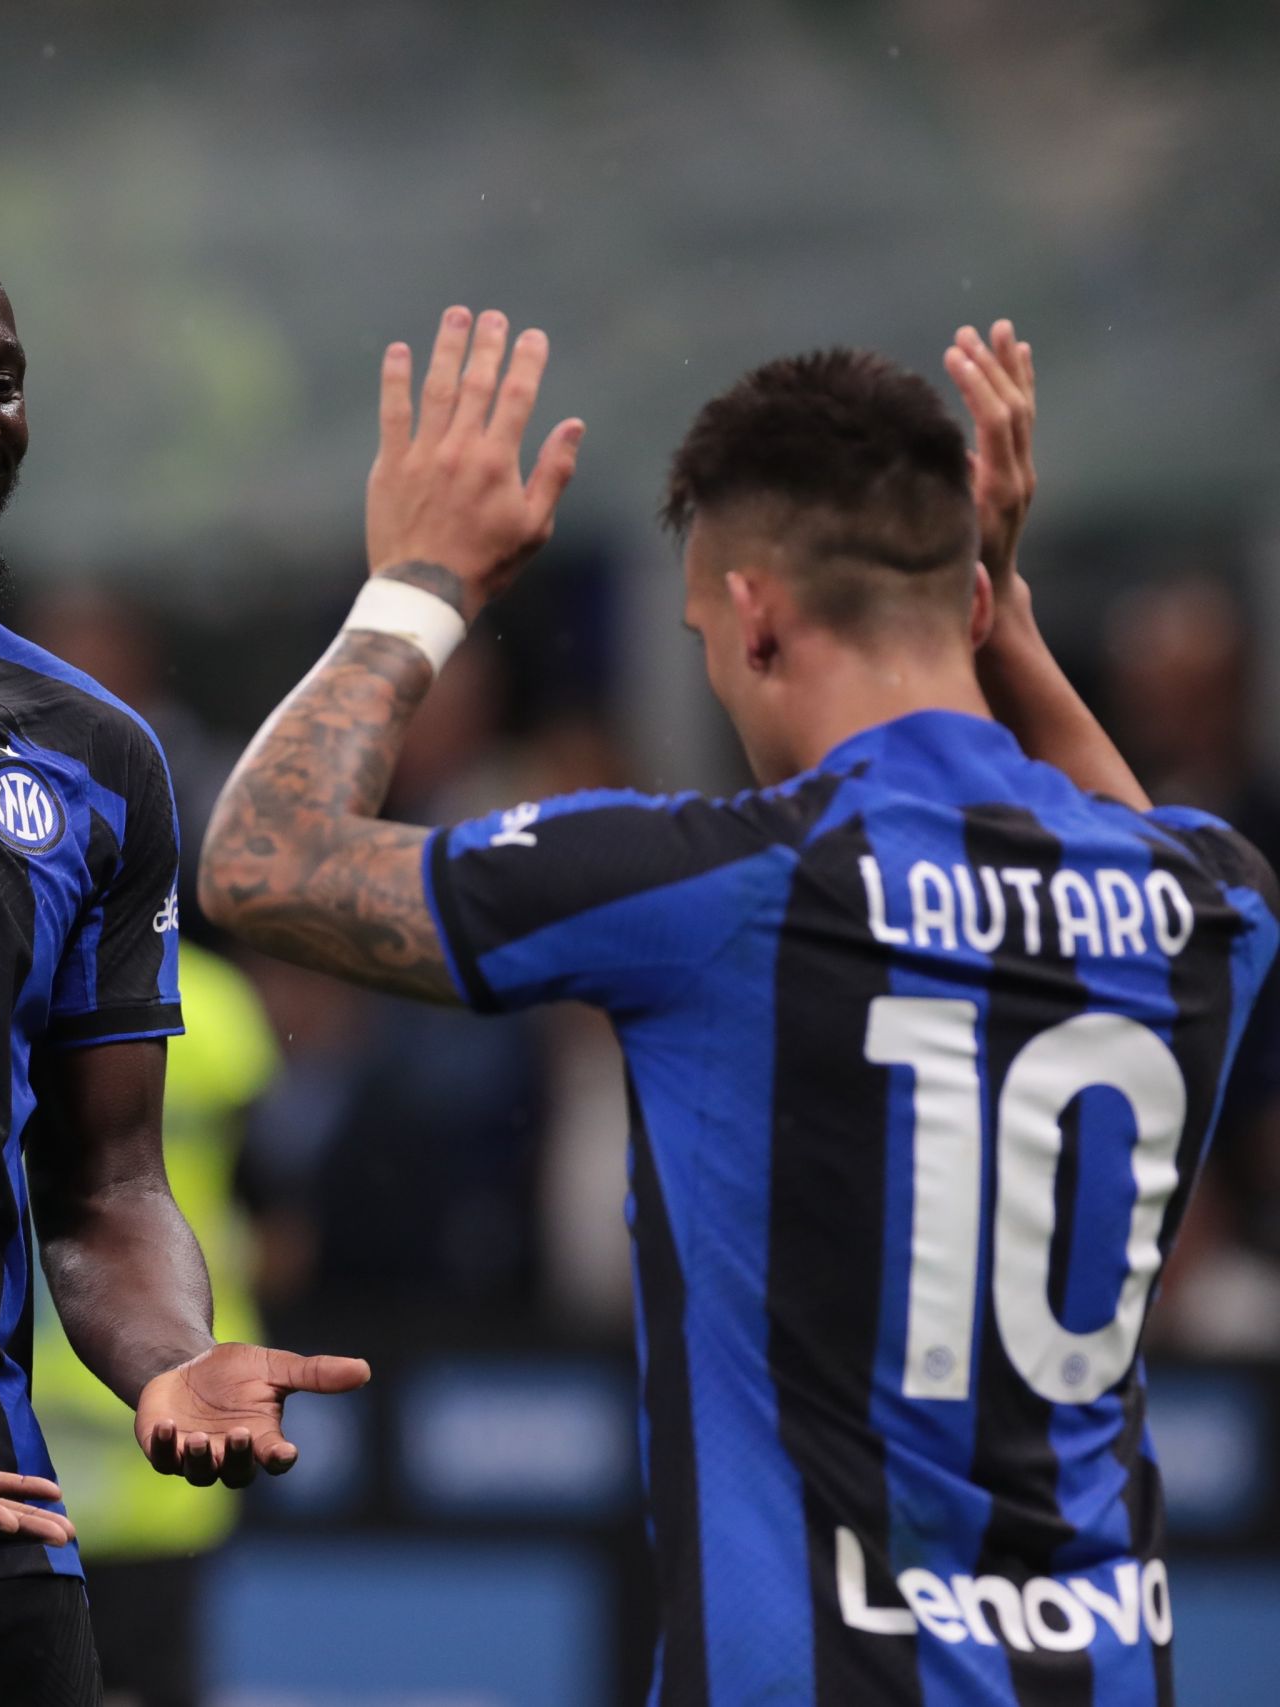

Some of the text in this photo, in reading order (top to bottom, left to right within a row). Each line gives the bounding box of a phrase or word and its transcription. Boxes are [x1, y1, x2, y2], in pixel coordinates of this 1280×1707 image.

[858, 855, 1195, 958] LAUTARO
[863, 995, 1188, 1405] 10
[834, 1525, 1173, 1653] Lenovo
